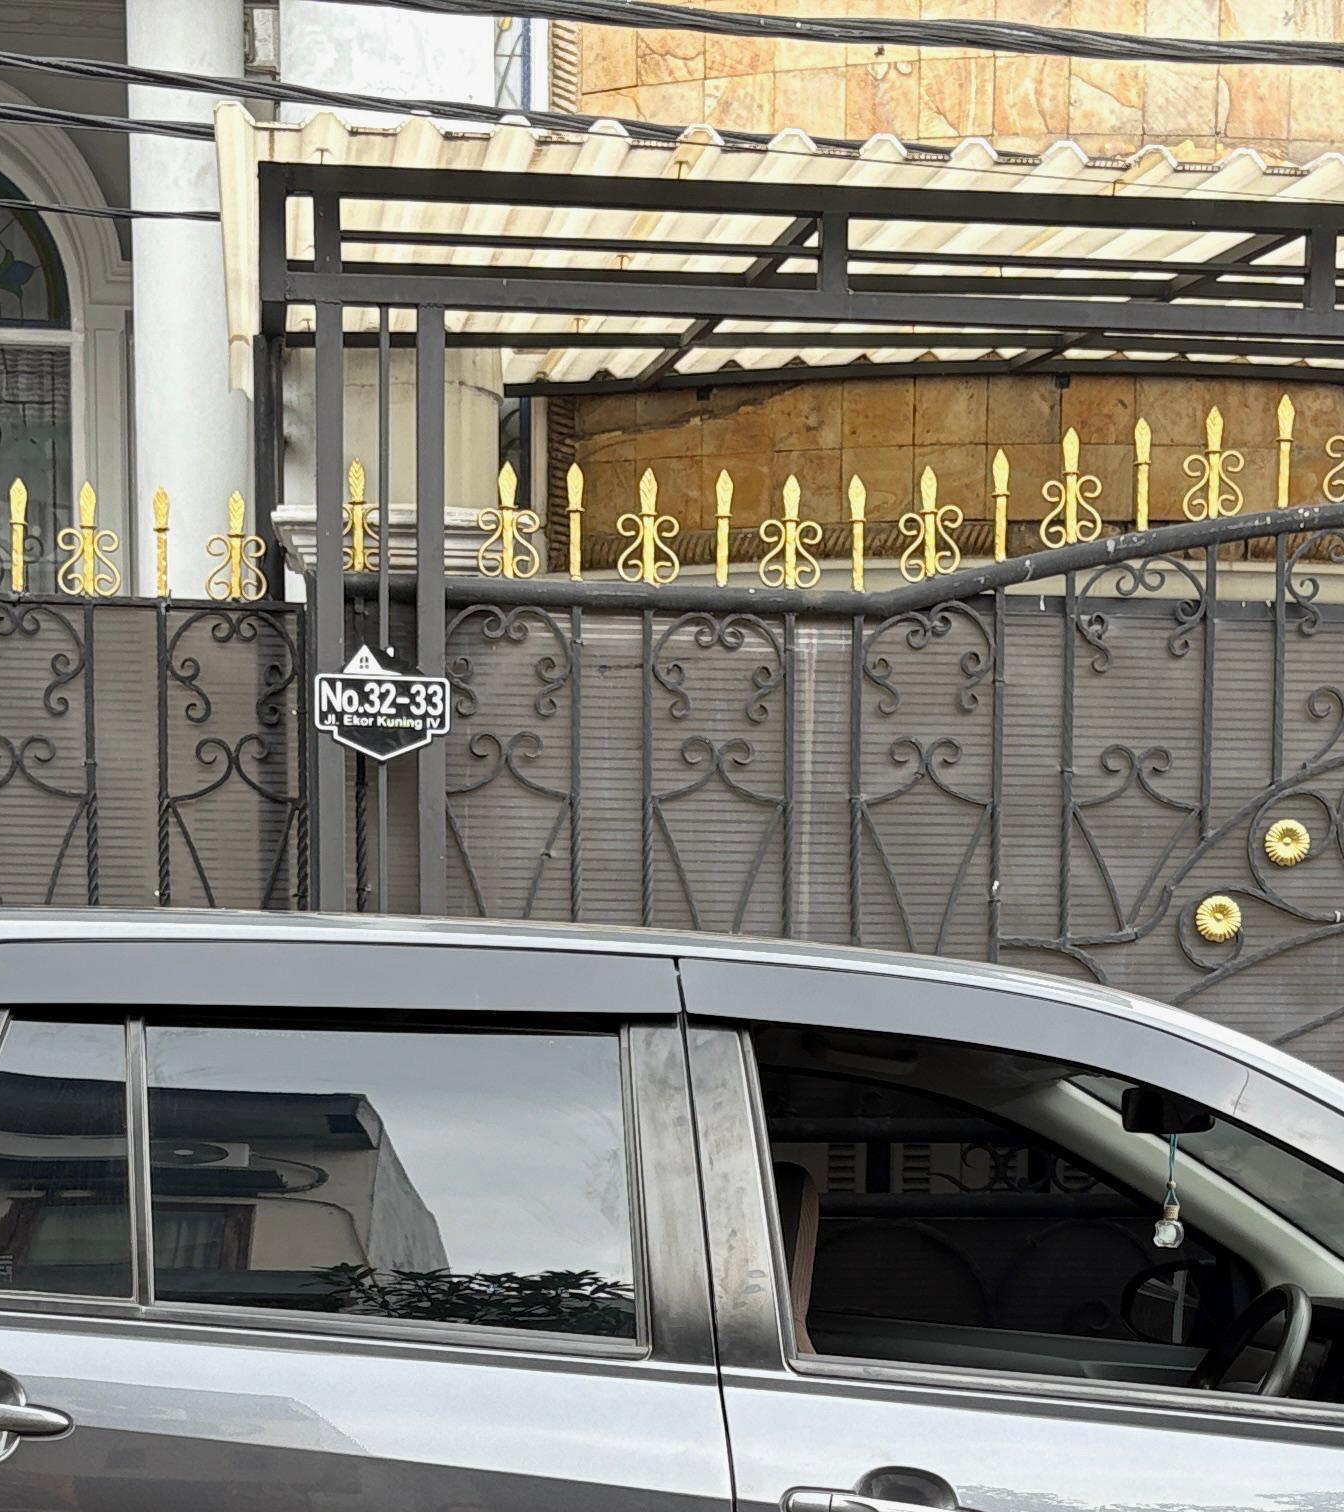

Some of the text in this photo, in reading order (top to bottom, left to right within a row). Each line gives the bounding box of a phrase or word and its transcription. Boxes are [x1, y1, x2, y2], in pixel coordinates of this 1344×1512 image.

[320, 680, 444, 716] No.32-33
[324, 714, 441, 730] Jl. Ekor Kuning IV
